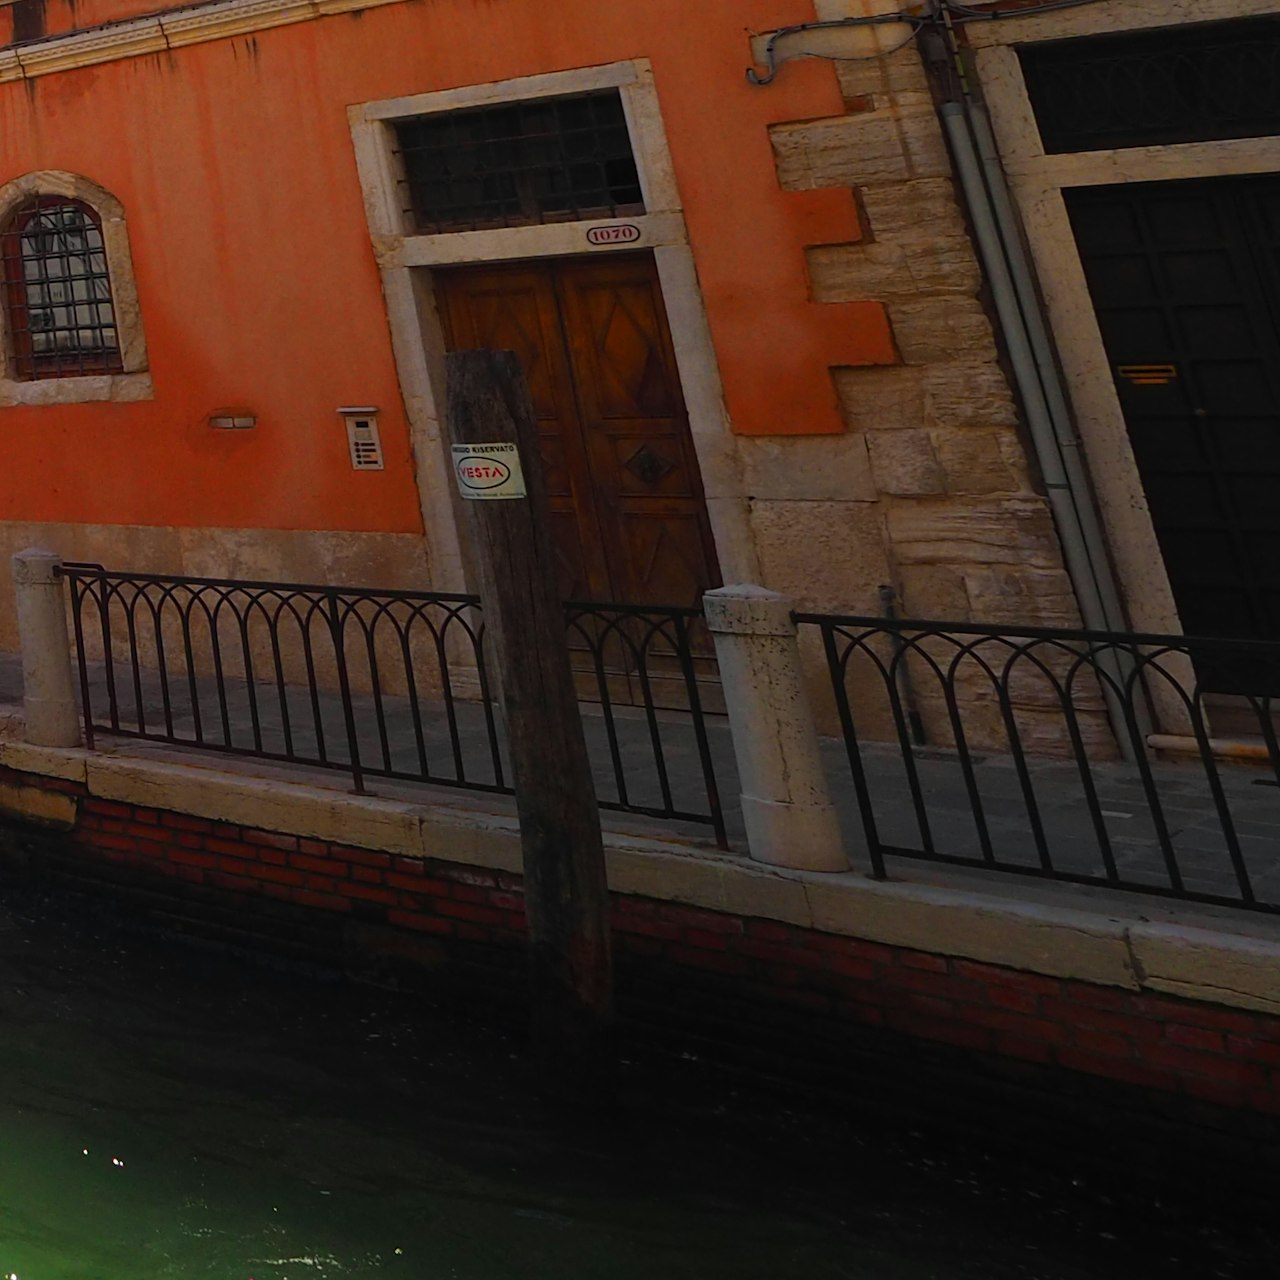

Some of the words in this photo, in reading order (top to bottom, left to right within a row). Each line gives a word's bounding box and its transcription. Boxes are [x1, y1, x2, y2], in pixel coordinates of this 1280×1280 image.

[592, 227, 632, 242] 1070
[471, 445, 515, 454] RISERVATO
[460, 466, 505, 479] VESTA
